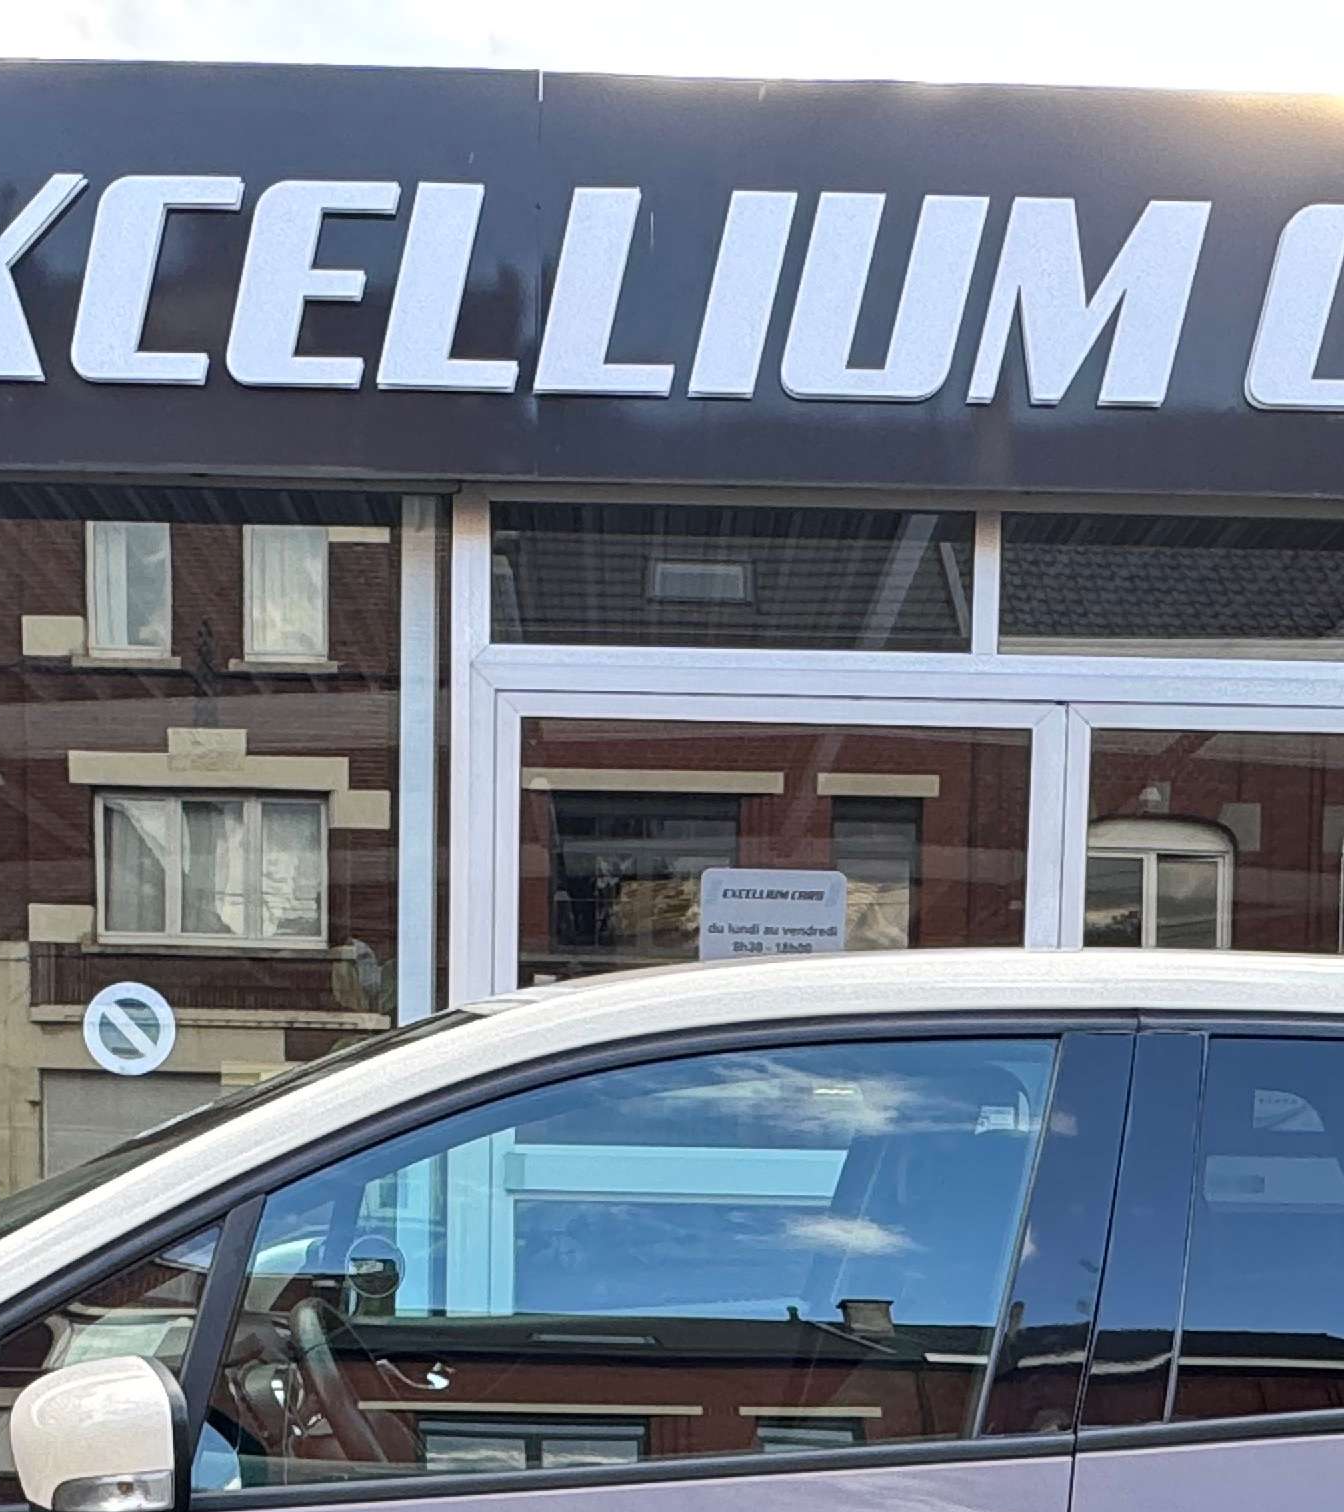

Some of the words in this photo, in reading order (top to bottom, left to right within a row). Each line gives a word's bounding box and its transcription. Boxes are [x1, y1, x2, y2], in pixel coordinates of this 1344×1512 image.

[708, 923, 724, 934] du
[728, 923, 760, 935] lundi
[763, 926, 779, 935] au
[783, 925, 838, 936] vendredi
